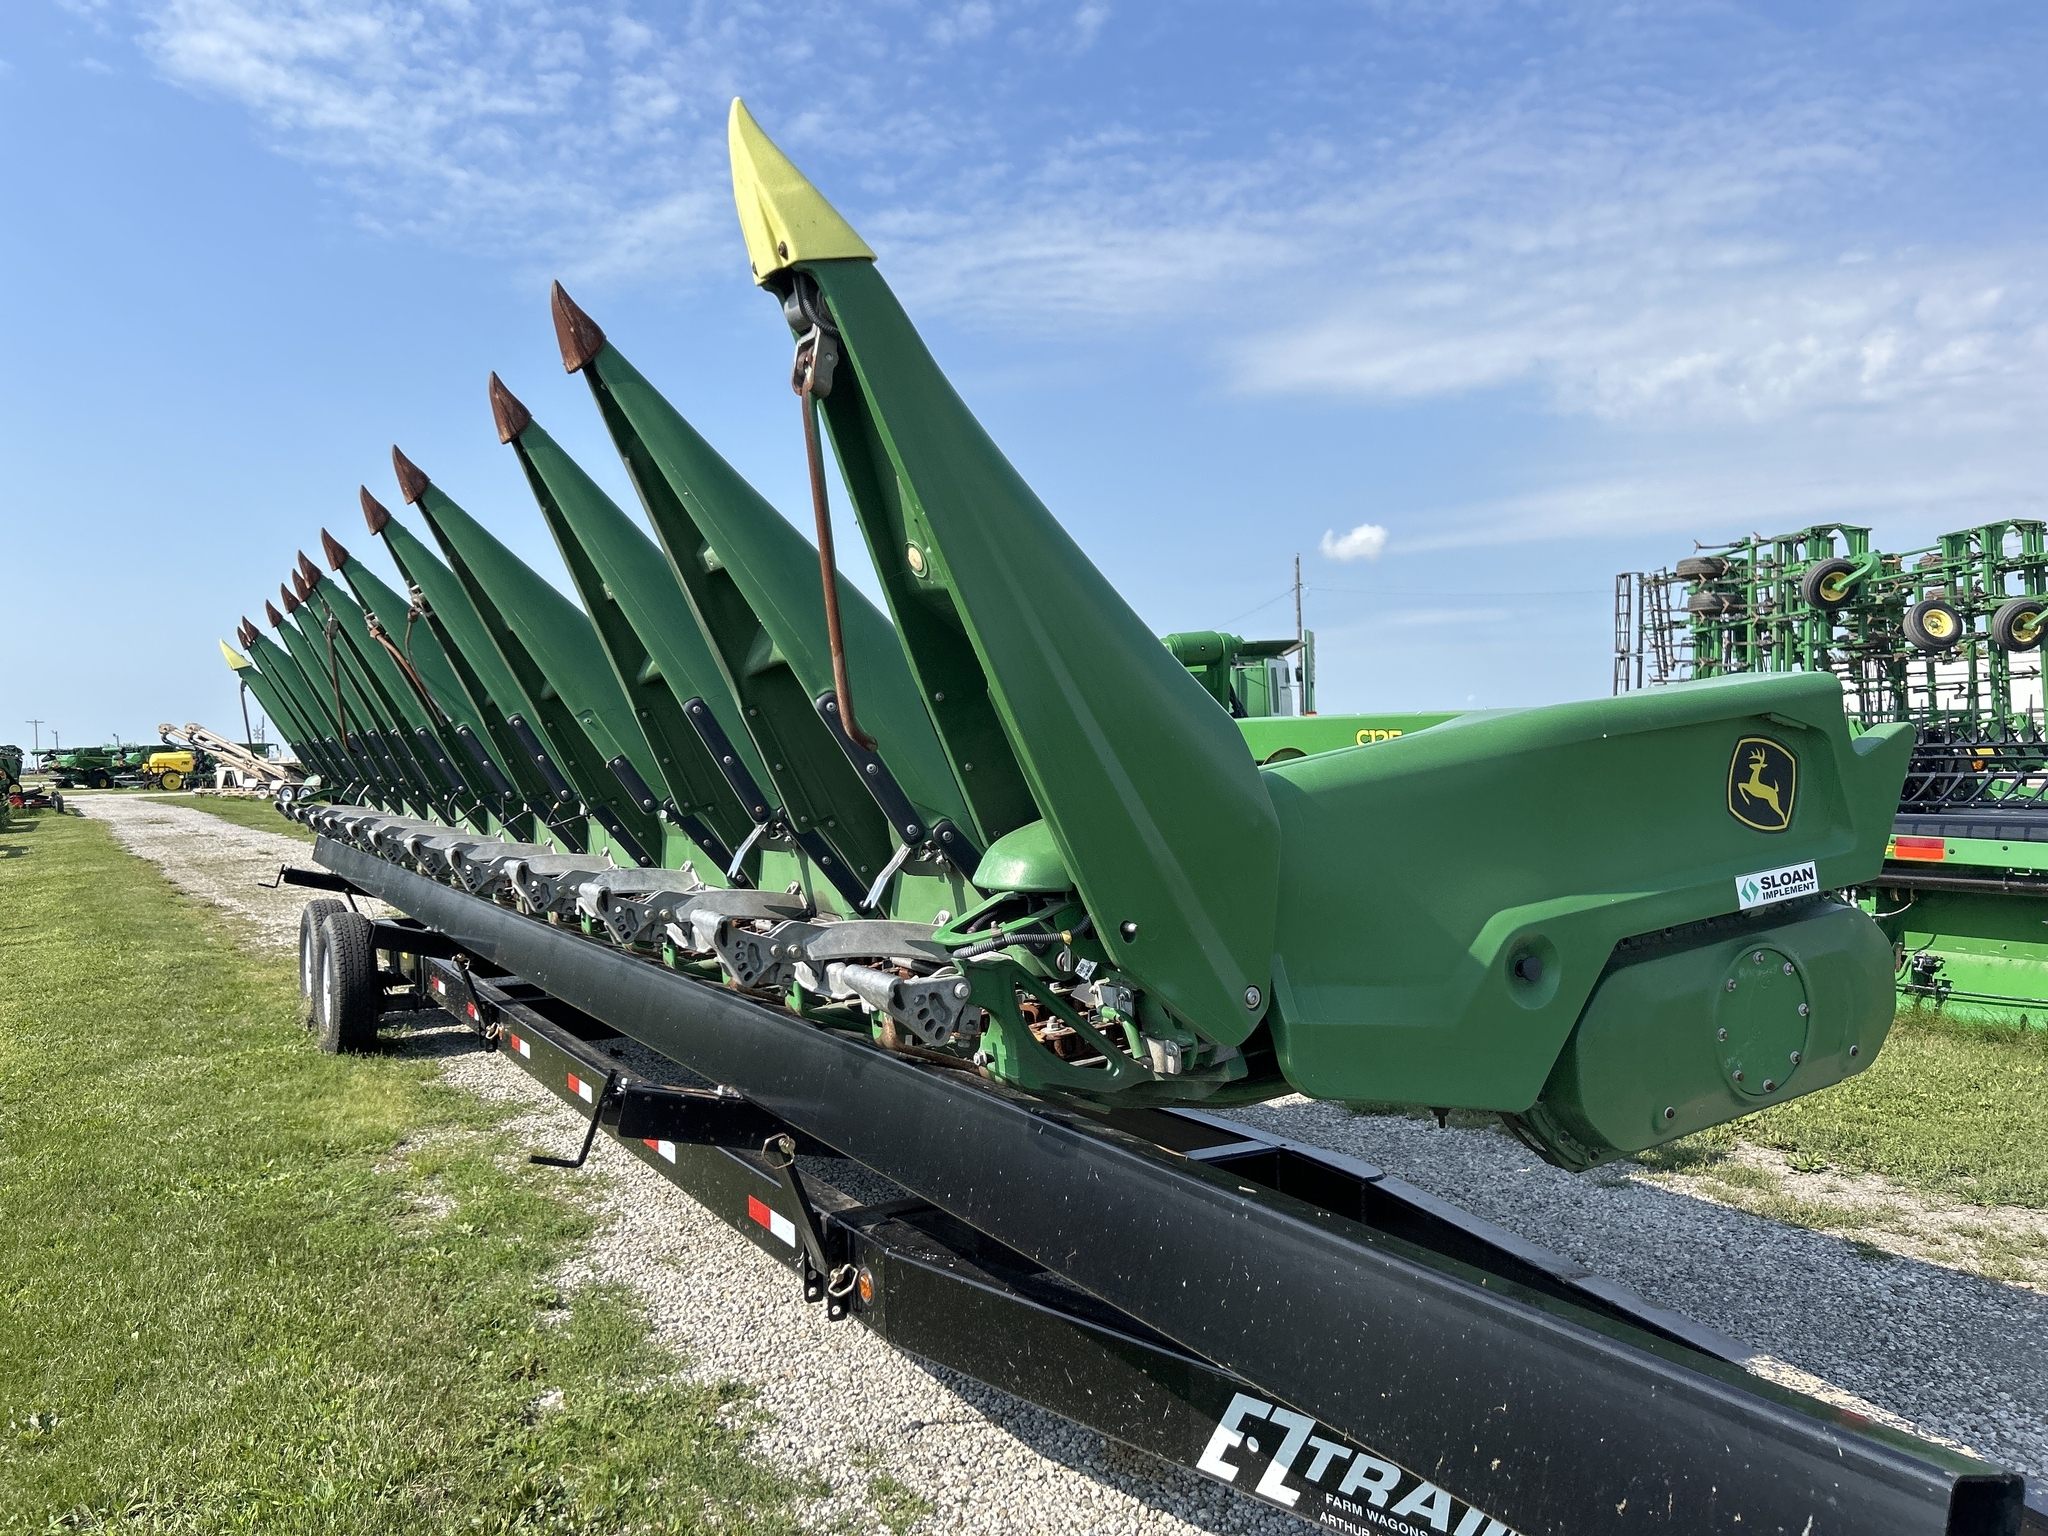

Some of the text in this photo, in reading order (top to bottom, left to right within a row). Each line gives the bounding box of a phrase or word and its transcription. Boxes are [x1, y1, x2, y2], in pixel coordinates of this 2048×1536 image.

[1760, 867, 1814, 890] SLOAN
[1762, 881, 1816, 900] IMPLEMENT
[1325, 1493, 1363, 1516] FARM
